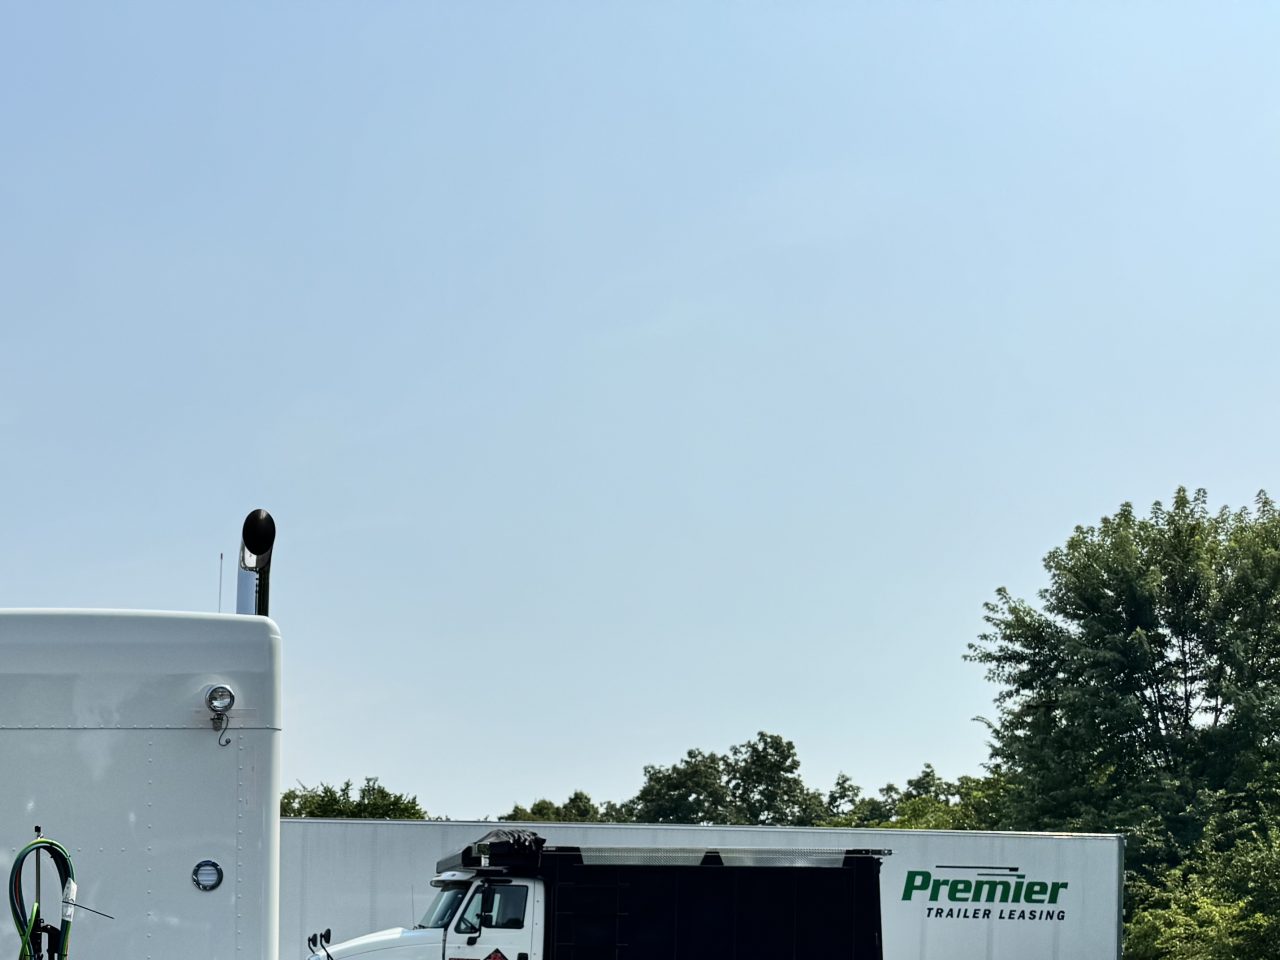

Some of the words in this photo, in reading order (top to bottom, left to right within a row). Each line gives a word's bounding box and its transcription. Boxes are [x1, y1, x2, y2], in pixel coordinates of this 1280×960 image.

[901, 870, 1069, 904] Premier
[926, 907, 992, 920] TRAILER
[998, 908, 1066, 921] LEASING
